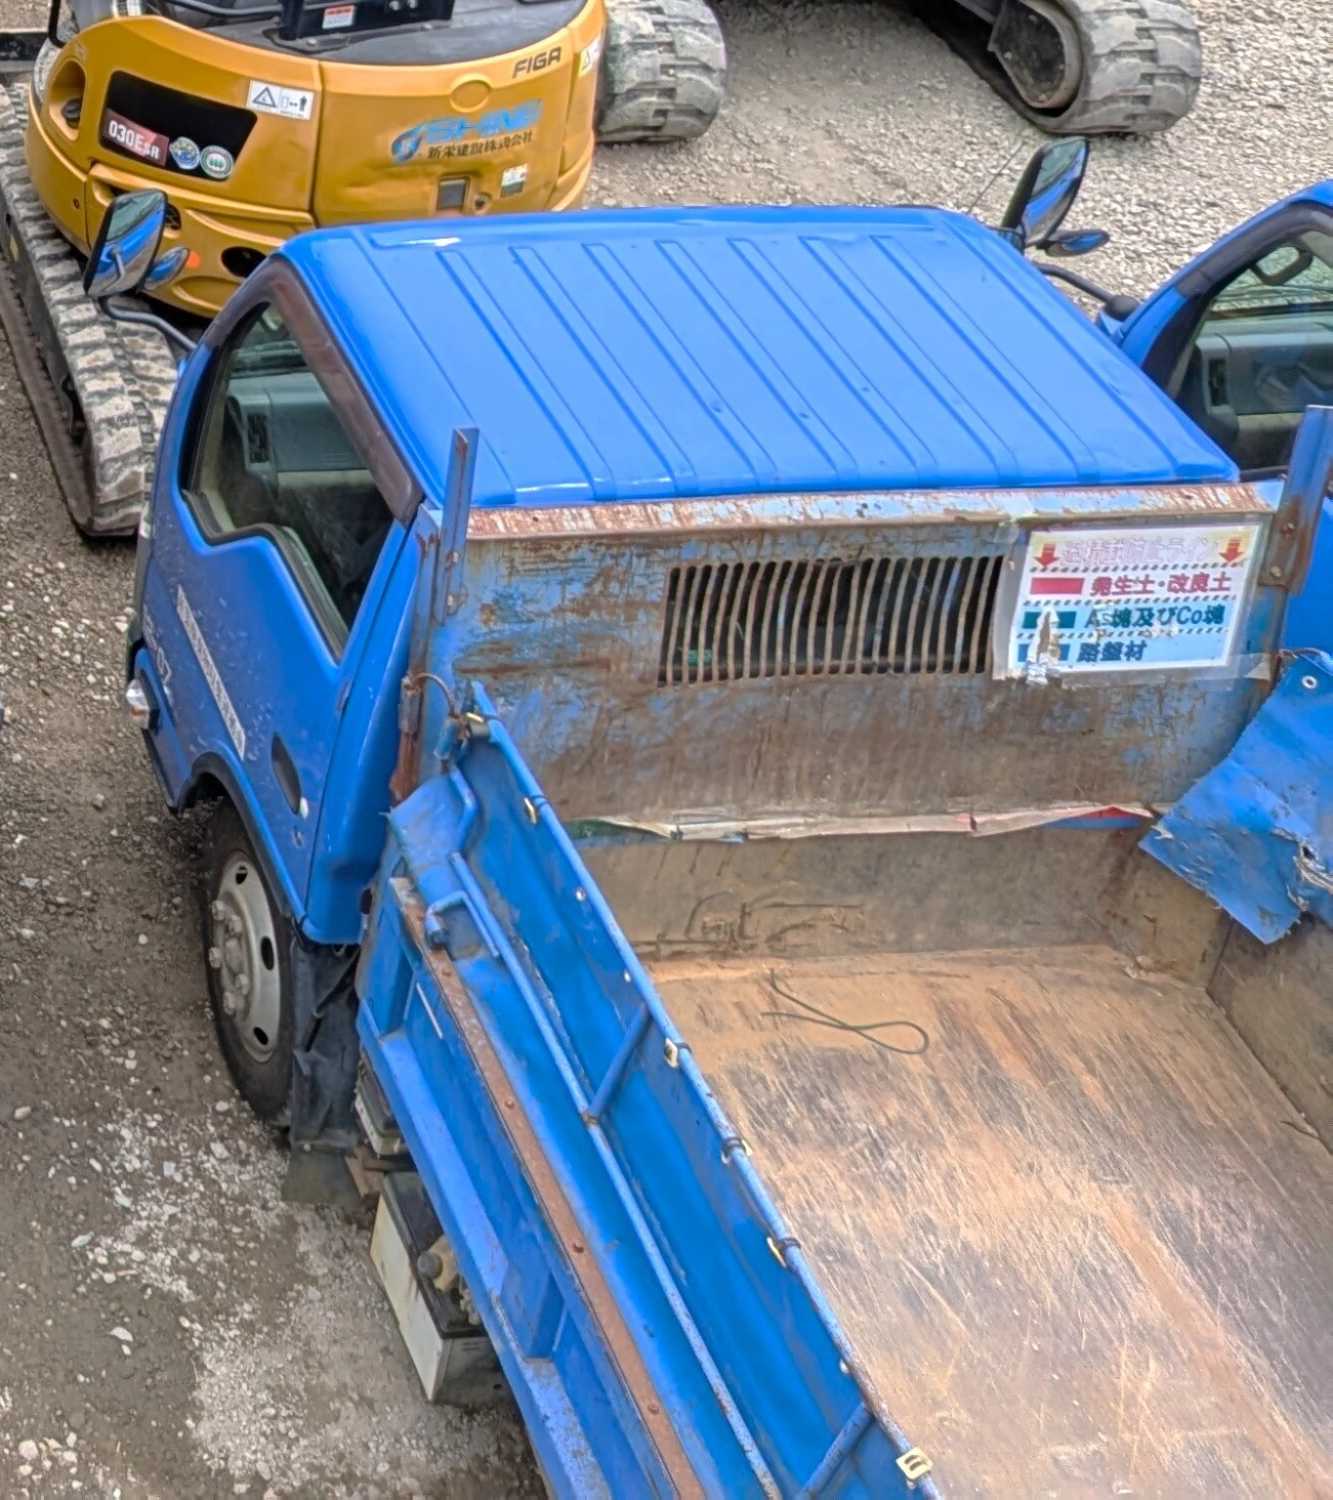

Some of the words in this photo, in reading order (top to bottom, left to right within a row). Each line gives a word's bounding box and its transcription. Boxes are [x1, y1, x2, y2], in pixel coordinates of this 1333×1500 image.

[512, 47, 562, 79] FIGA
[1077, 639, 1148, 663] 路盤材
